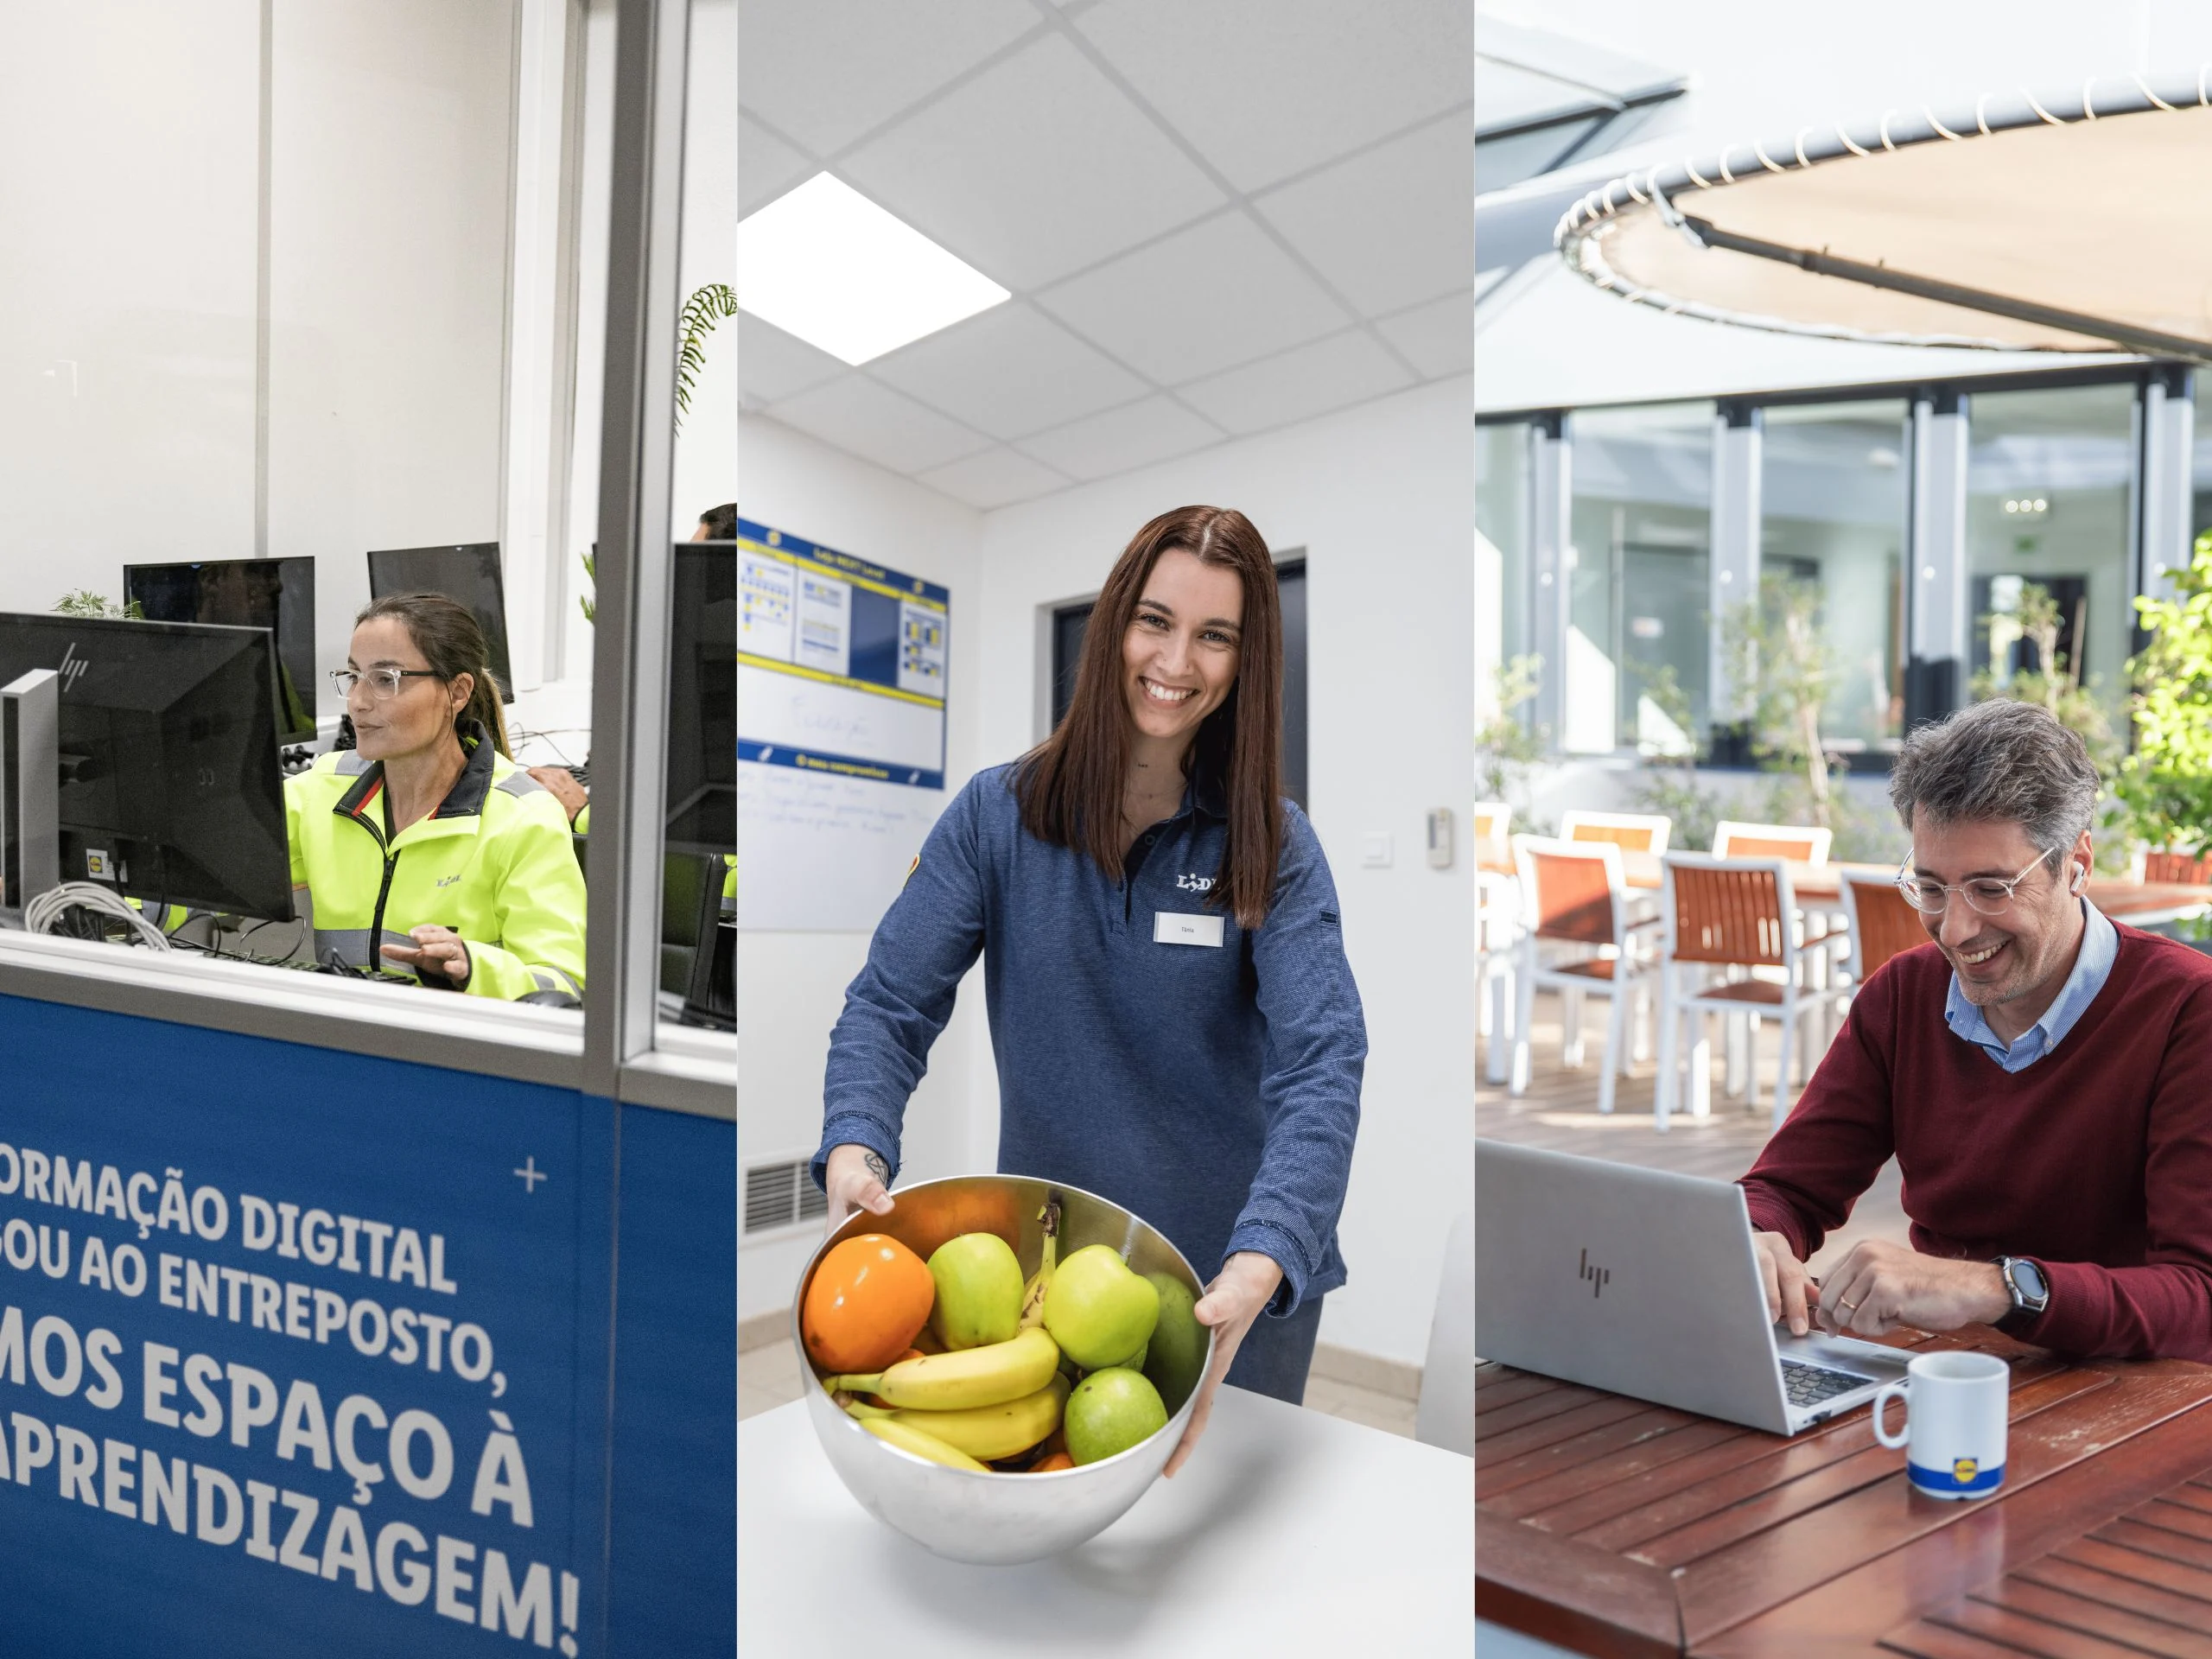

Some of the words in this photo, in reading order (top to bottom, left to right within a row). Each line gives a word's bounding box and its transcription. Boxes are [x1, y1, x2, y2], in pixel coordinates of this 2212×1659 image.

[0, 1142, 229, 1241] ORMAÇÃO
[239, 1194, 457, 1294] DIGITAL
[0, 1218, 70, 1279] OU
[79, 1236, 148, 1298] AO
[159, 1253, 506, 1398] ENTREPOSTO,
[143, 1341, 454, 1505] ESPAÇO
[471, 1409, 533, 1528] À
[0, 1411, 579, 1659] PRENDIZAGEM!
